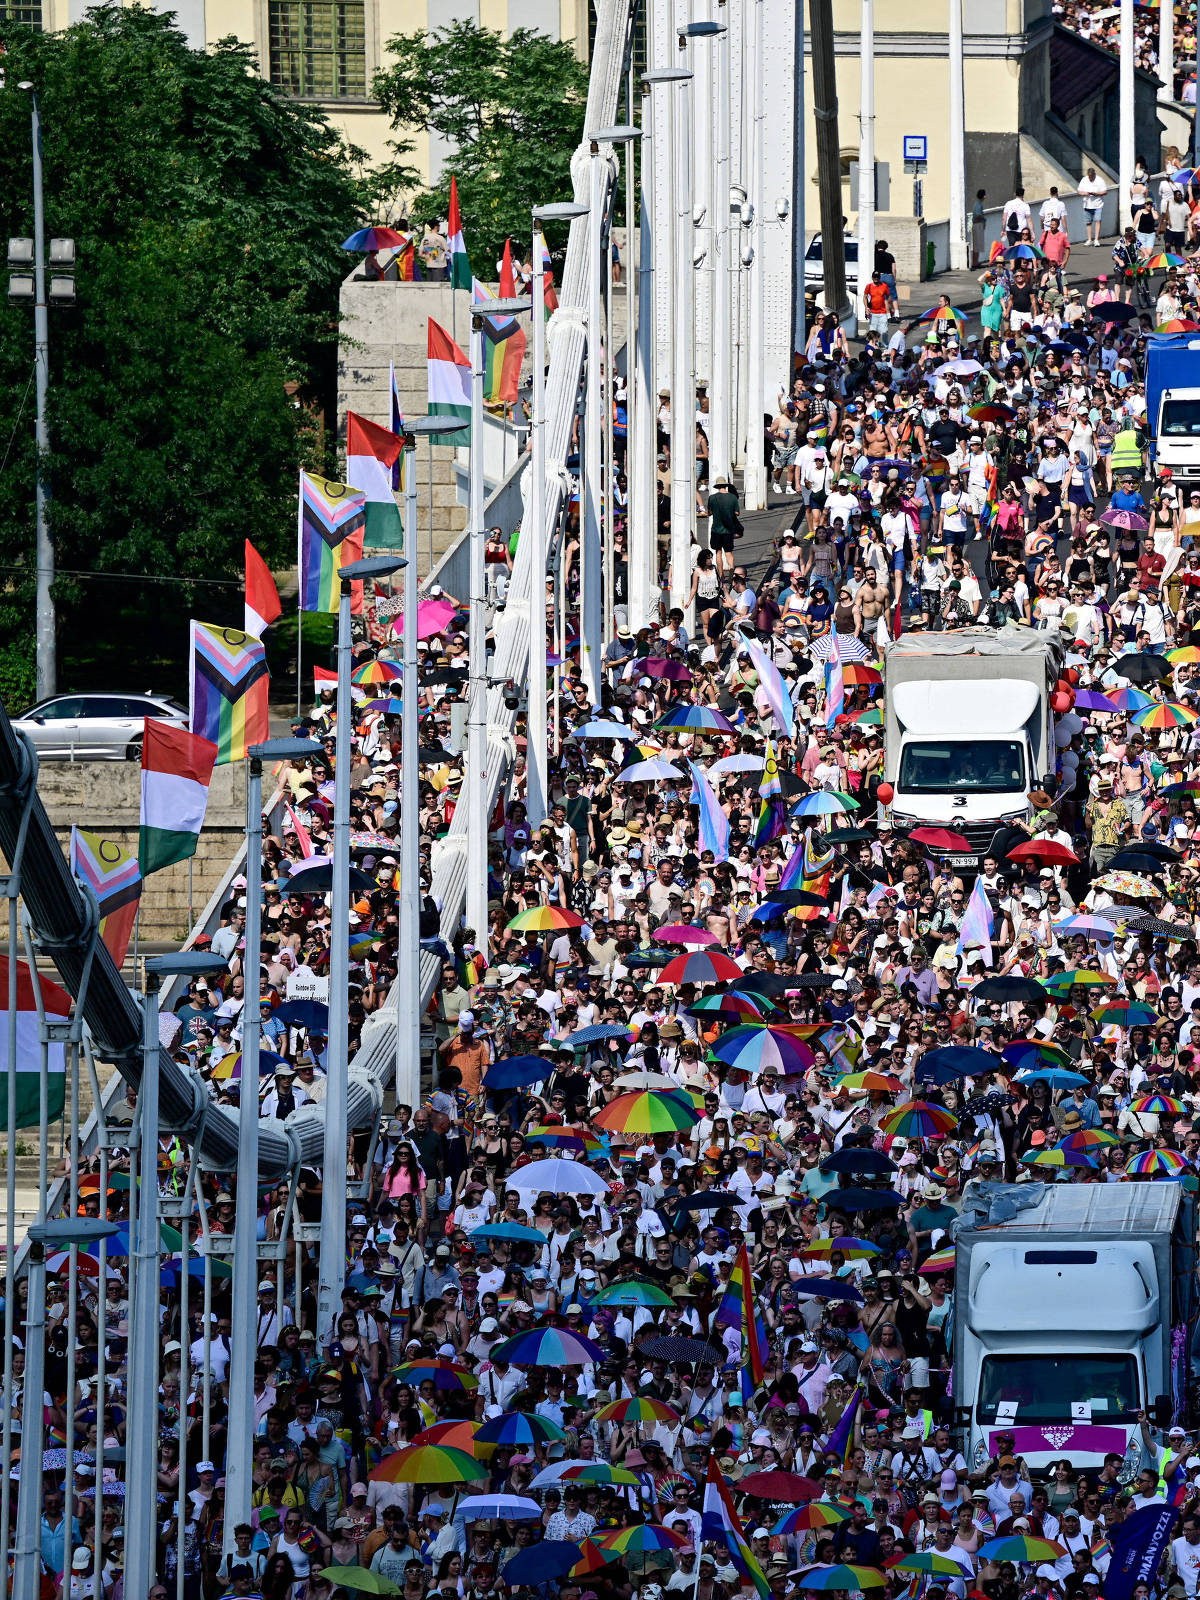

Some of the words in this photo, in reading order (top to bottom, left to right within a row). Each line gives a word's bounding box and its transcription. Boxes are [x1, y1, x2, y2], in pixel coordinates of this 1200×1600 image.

[953, 796, 968, 808] 3
[1004, 1408, 1010, 1417] 2
[1078, 1406, 1085, 1414] 2
[1136, 1511, 1172, 1583] OMÁNYOZZ!
